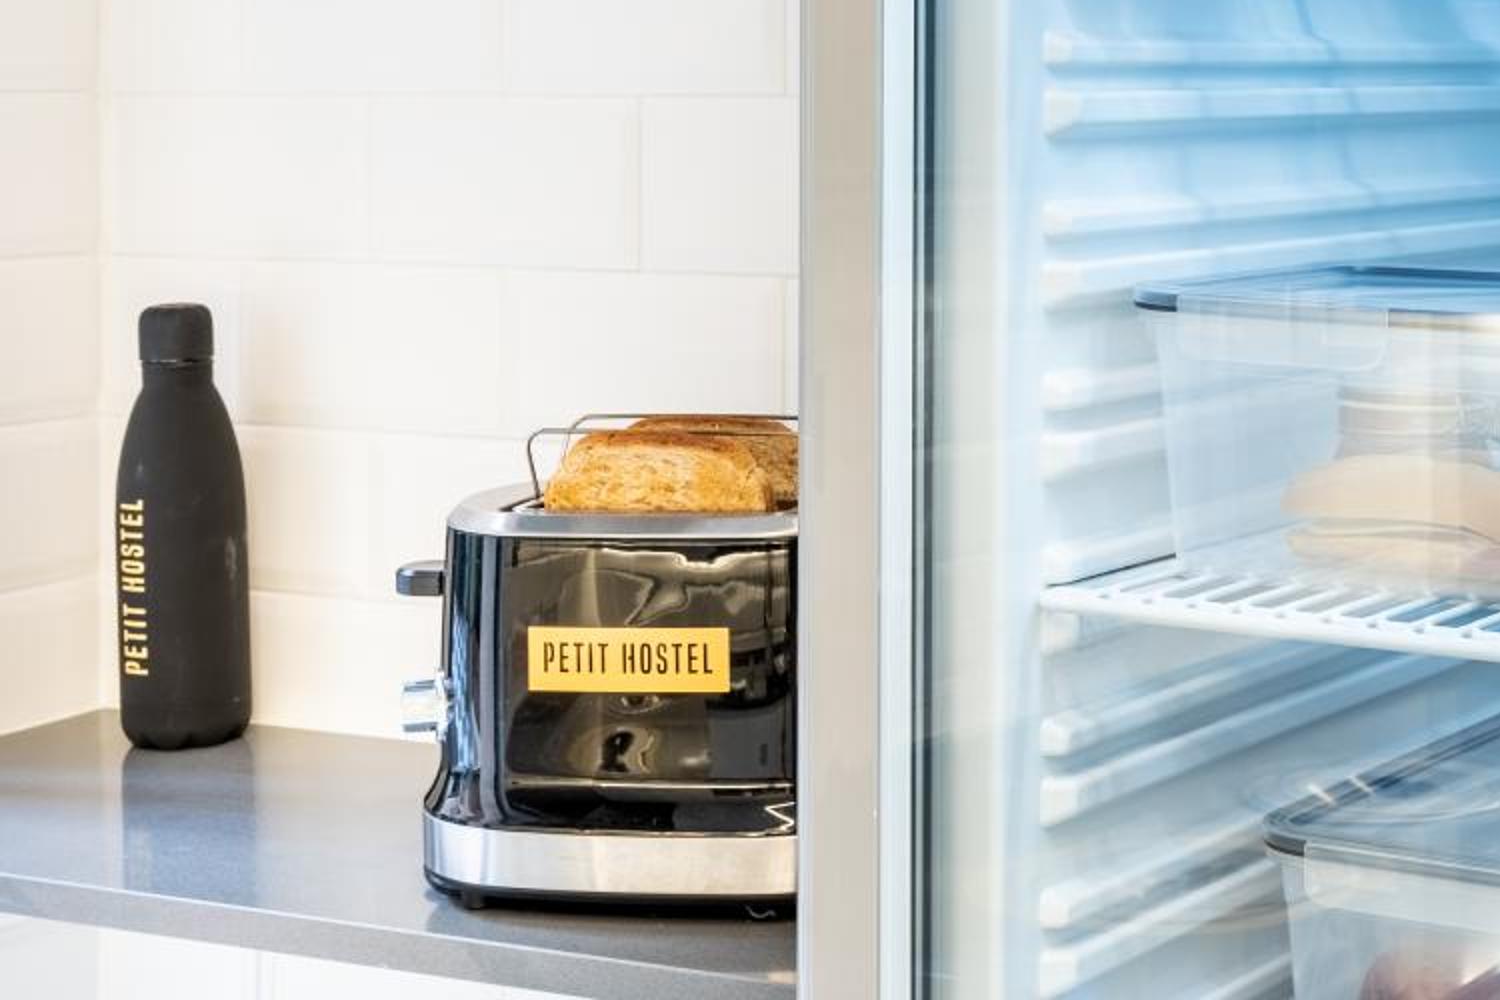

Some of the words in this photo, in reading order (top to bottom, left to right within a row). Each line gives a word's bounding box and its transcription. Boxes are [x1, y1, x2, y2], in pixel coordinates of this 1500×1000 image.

[119, 499, 145, 593] HOSTEL
[122, 603, 149, 676] PETIT
[543, 642, 609, 674] PETIT
[622, 642, 713, 675] HOSTEL
